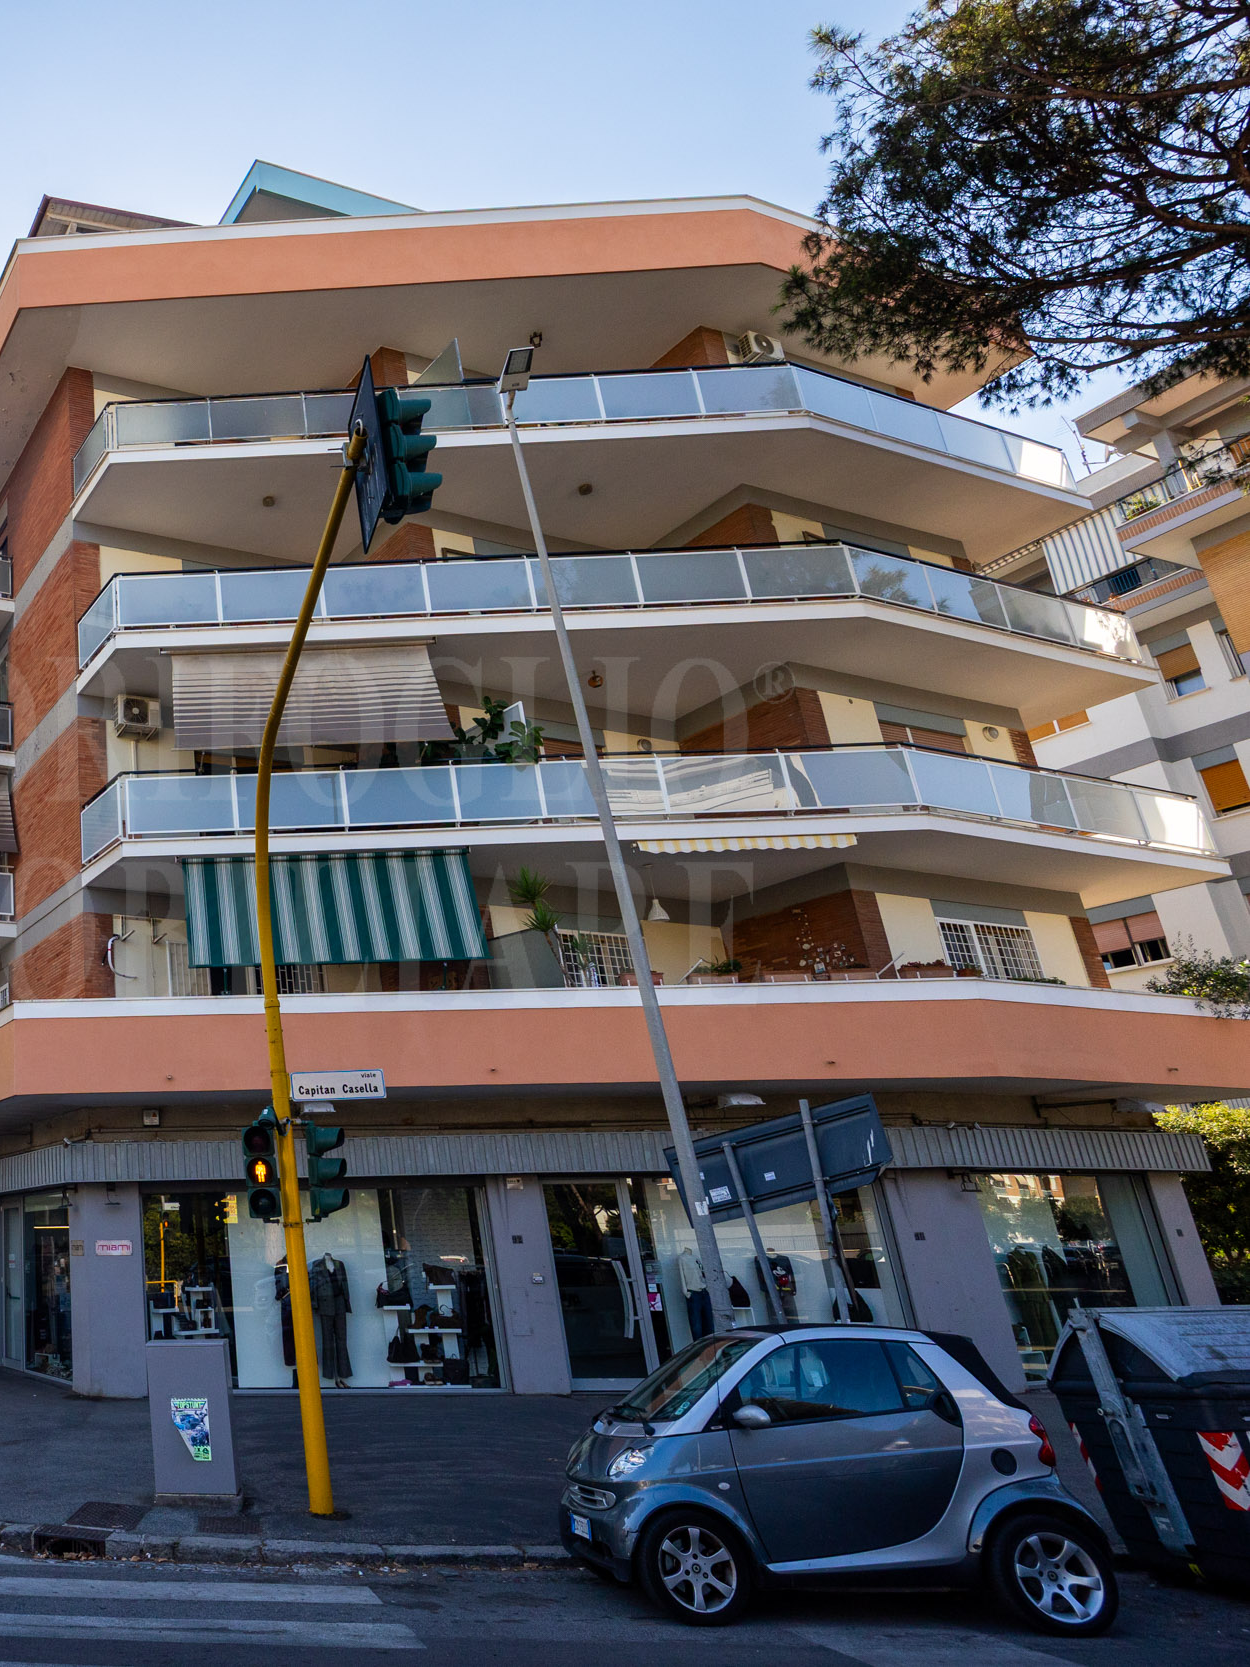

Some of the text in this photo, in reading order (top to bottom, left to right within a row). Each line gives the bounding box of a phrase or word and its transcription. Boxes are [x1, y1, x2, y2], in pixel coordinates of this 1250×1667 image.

[298, 1083, 379, 1097] Capitan Casella
[97, 1244, 131, 1252] miami
